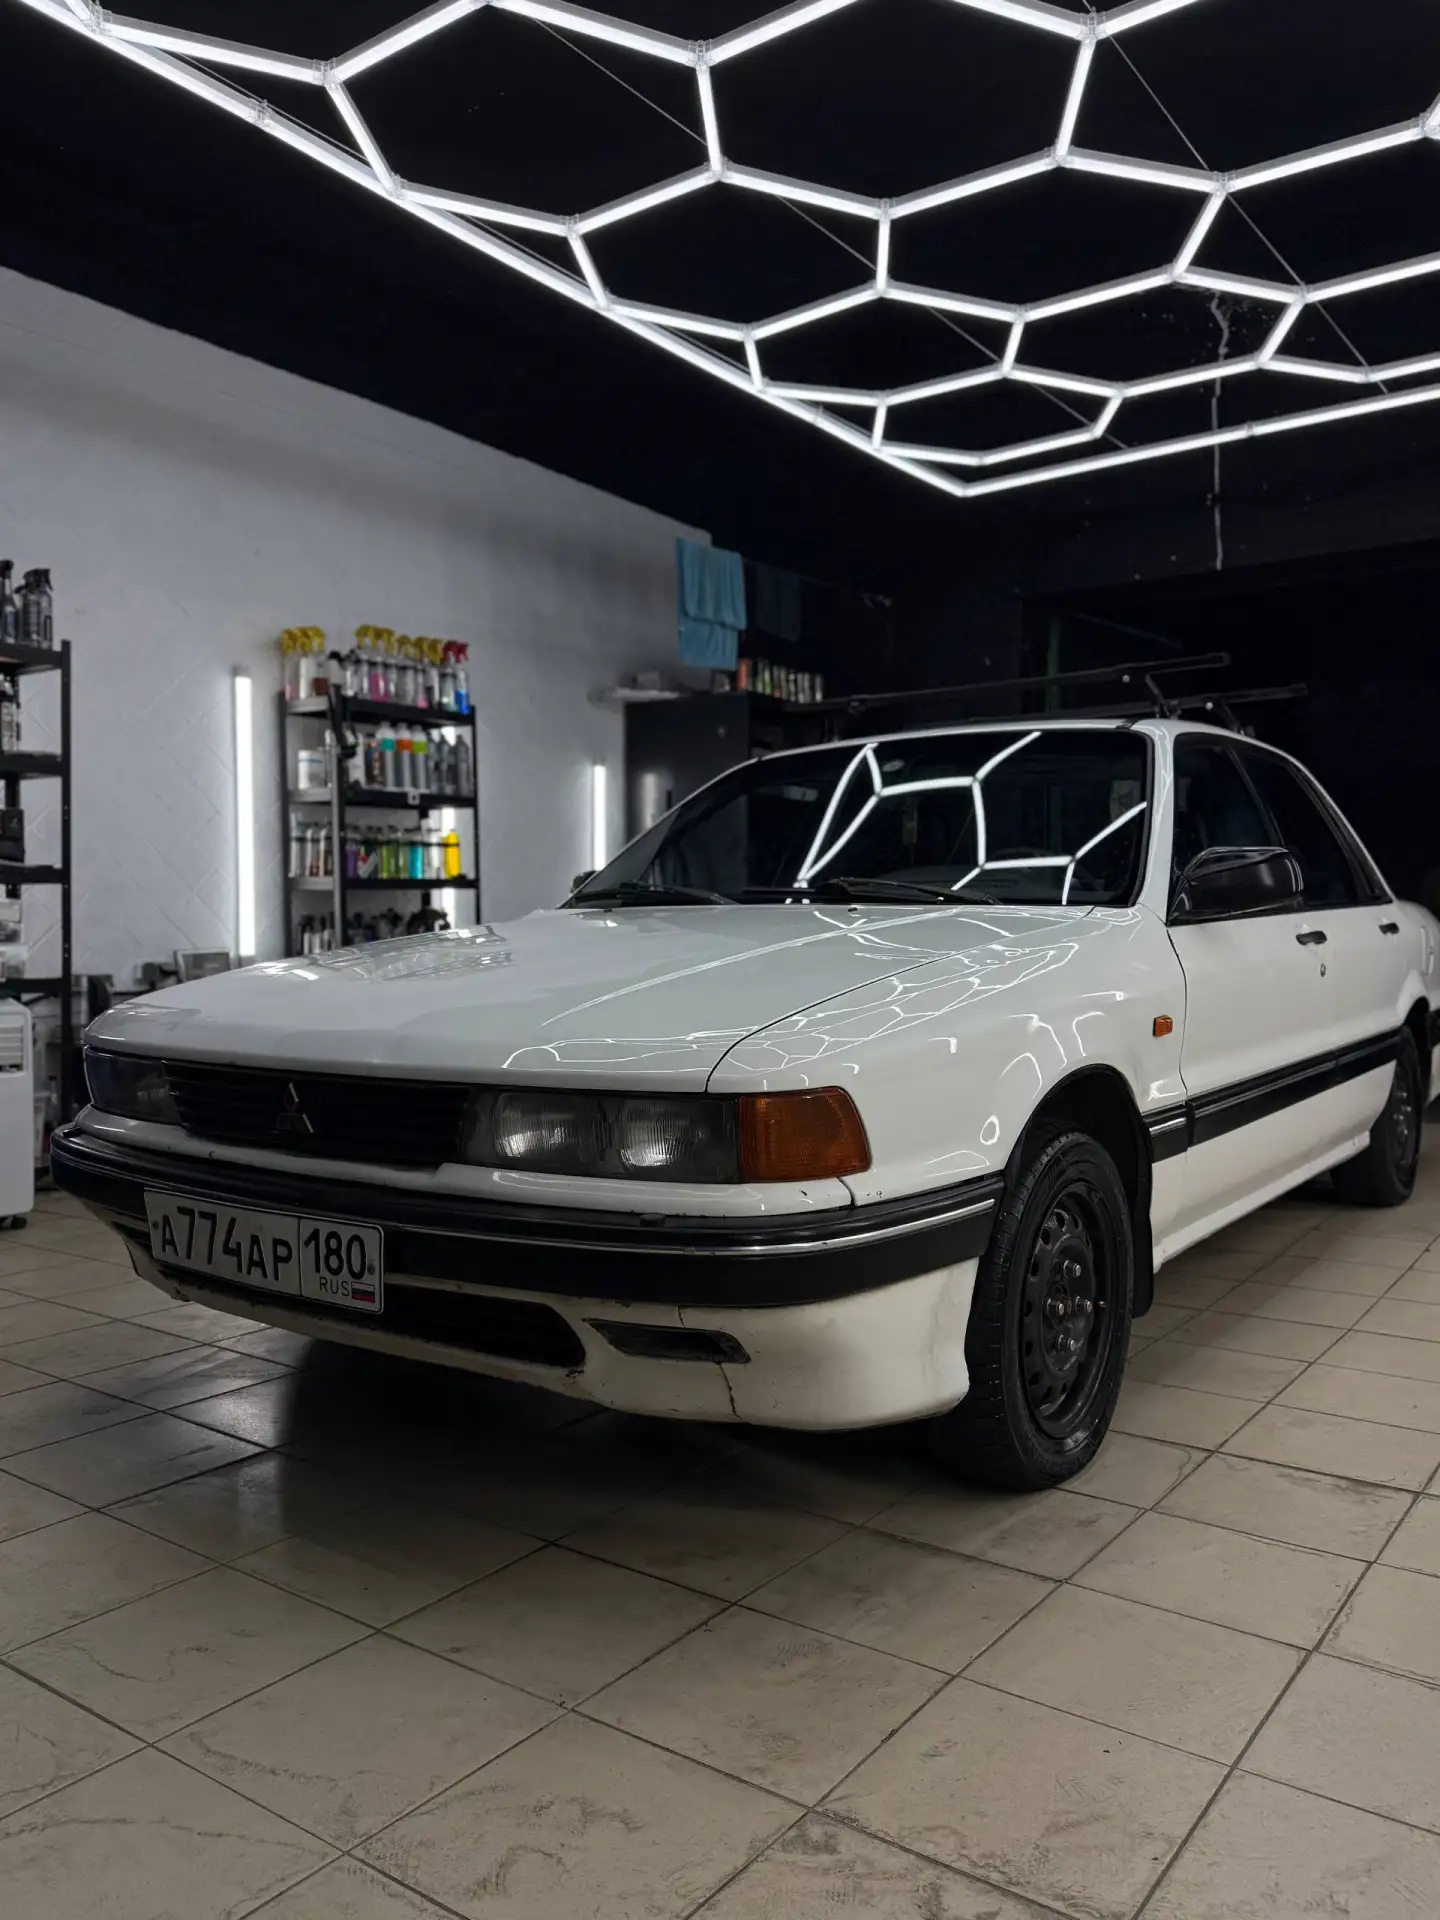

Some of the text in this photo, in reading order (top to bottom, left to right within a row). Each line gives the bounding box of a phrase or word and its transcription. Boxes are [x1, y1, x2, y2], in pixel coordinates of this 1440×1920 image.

[161, 1206, 367, 1281] A774AP 180
[319, 1276, 350, 1297] RUS
